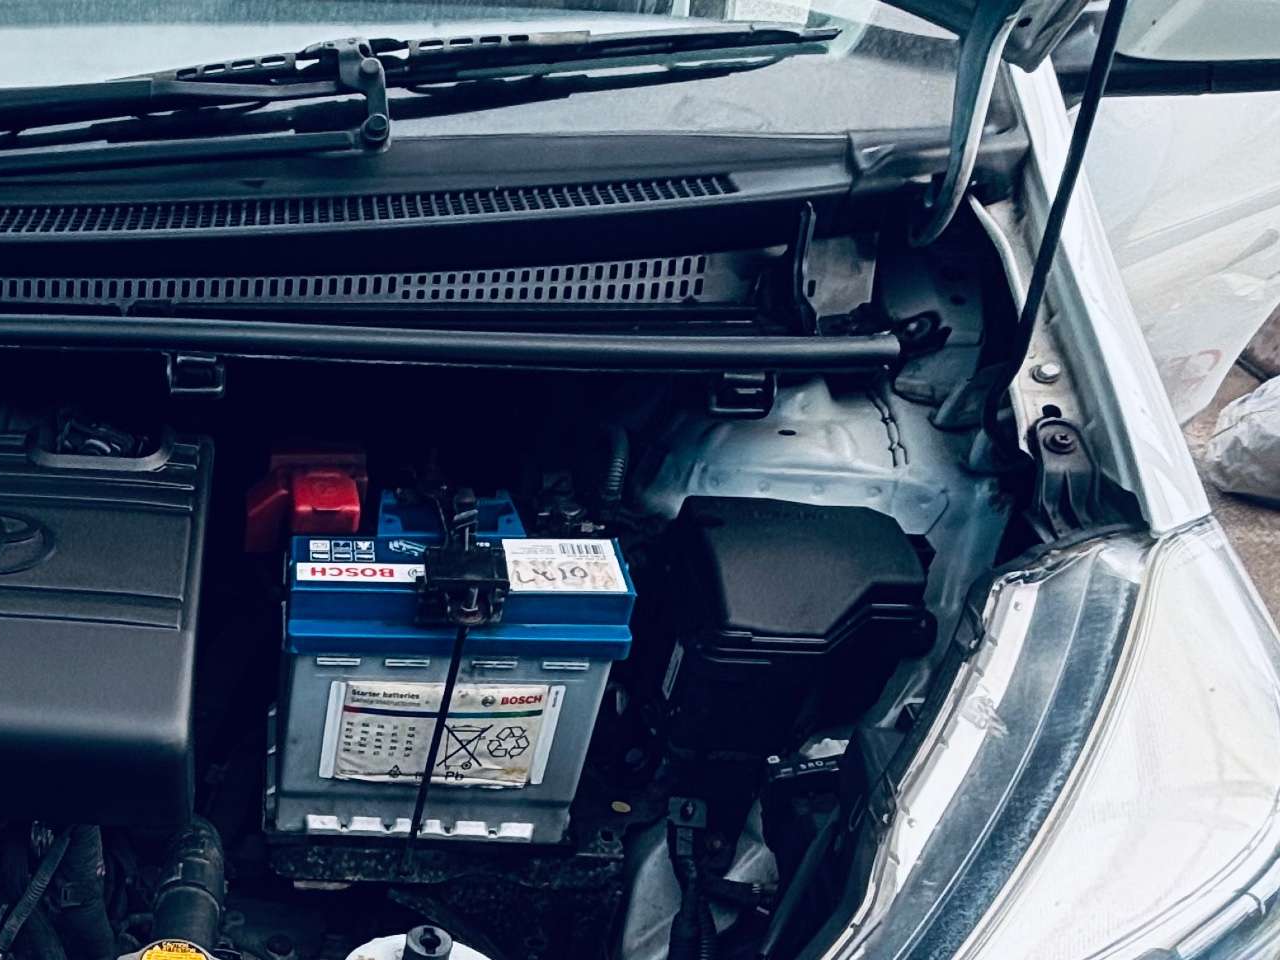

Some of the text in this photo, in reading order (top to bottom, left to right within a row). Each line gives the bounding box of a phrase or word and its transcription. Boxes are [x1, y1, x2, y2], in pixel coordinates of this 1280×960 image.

[310, 566, 395, 578] BOSCH
[351, 688, 420, 700] Starter batteries
[500, 693, 544, 706] BOSCH
[445, 770, 465, 781] Pb
